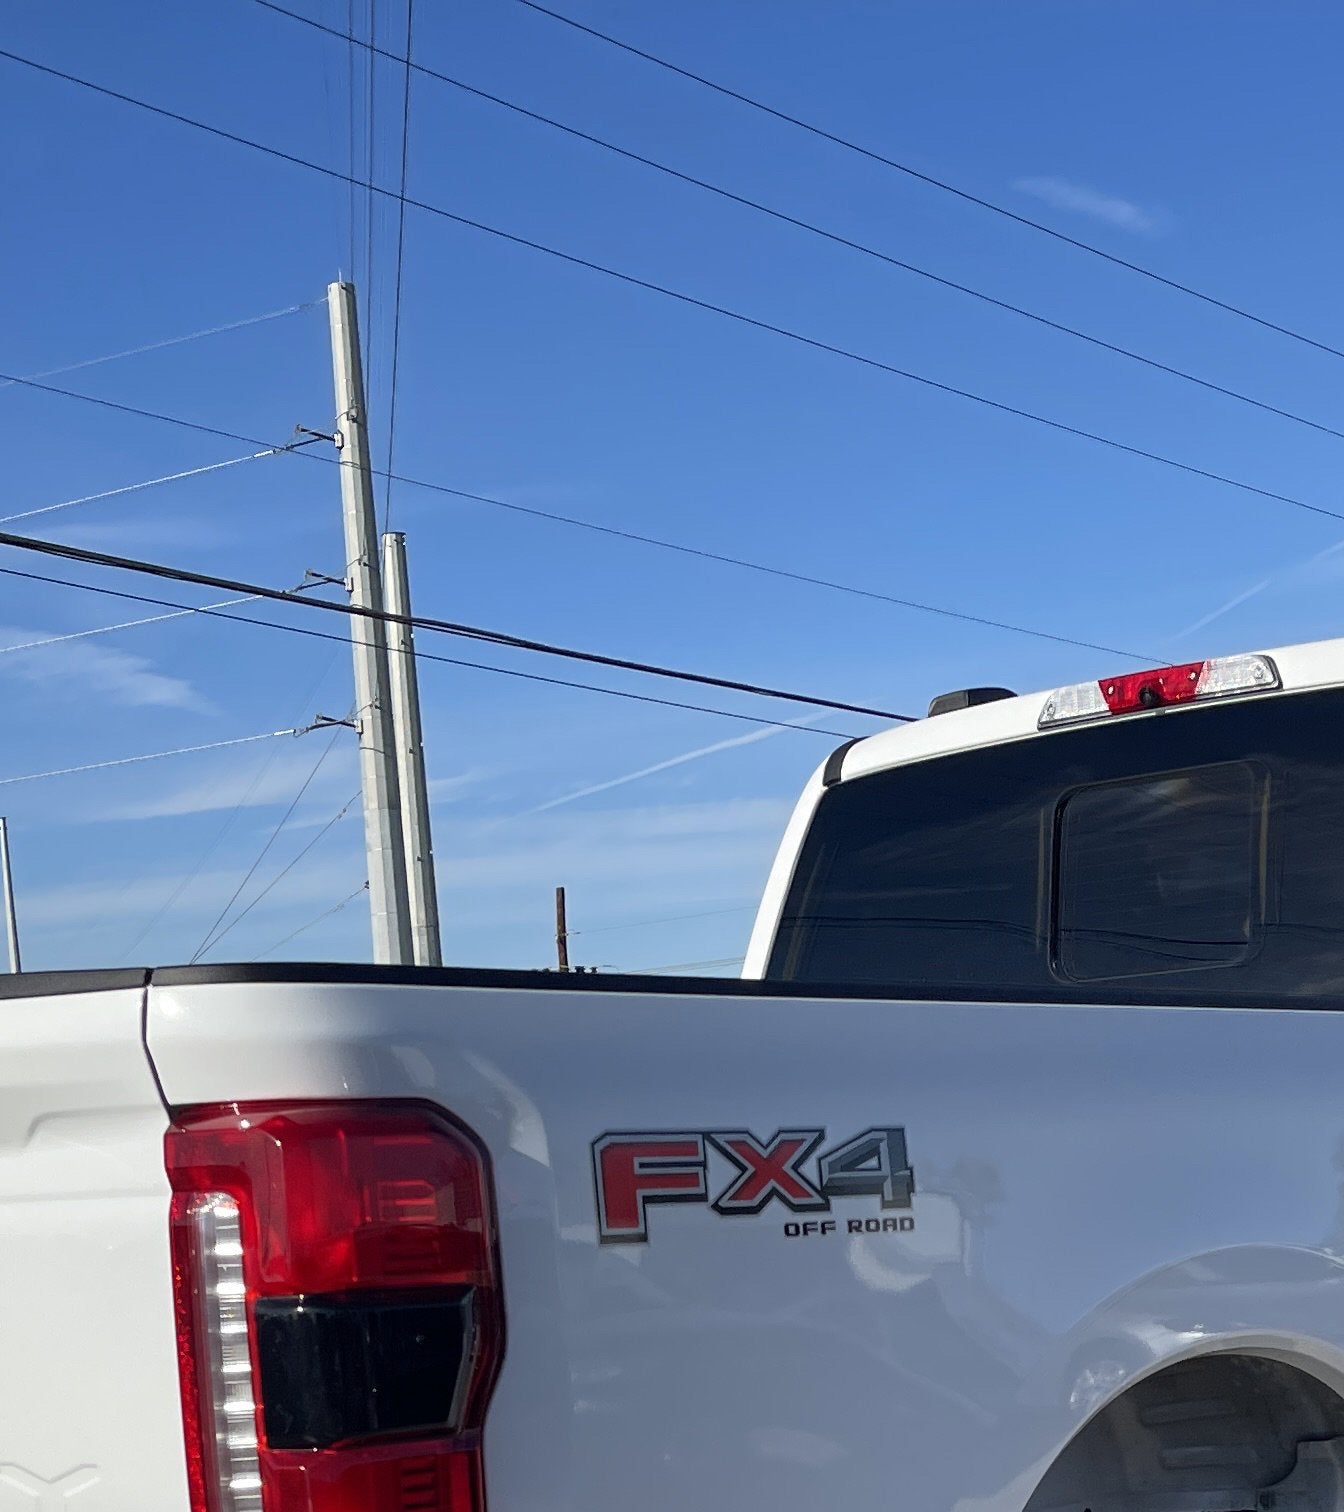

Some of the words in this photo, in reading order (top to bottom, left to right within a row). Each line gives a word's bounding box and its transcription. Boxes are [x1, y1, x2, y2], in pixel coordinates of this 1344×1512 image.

[591, 1127, 915, 1246] FX4
[783, 1219, 837, 1238] OFF
[846, 1216, 916, 1234] ROAD
